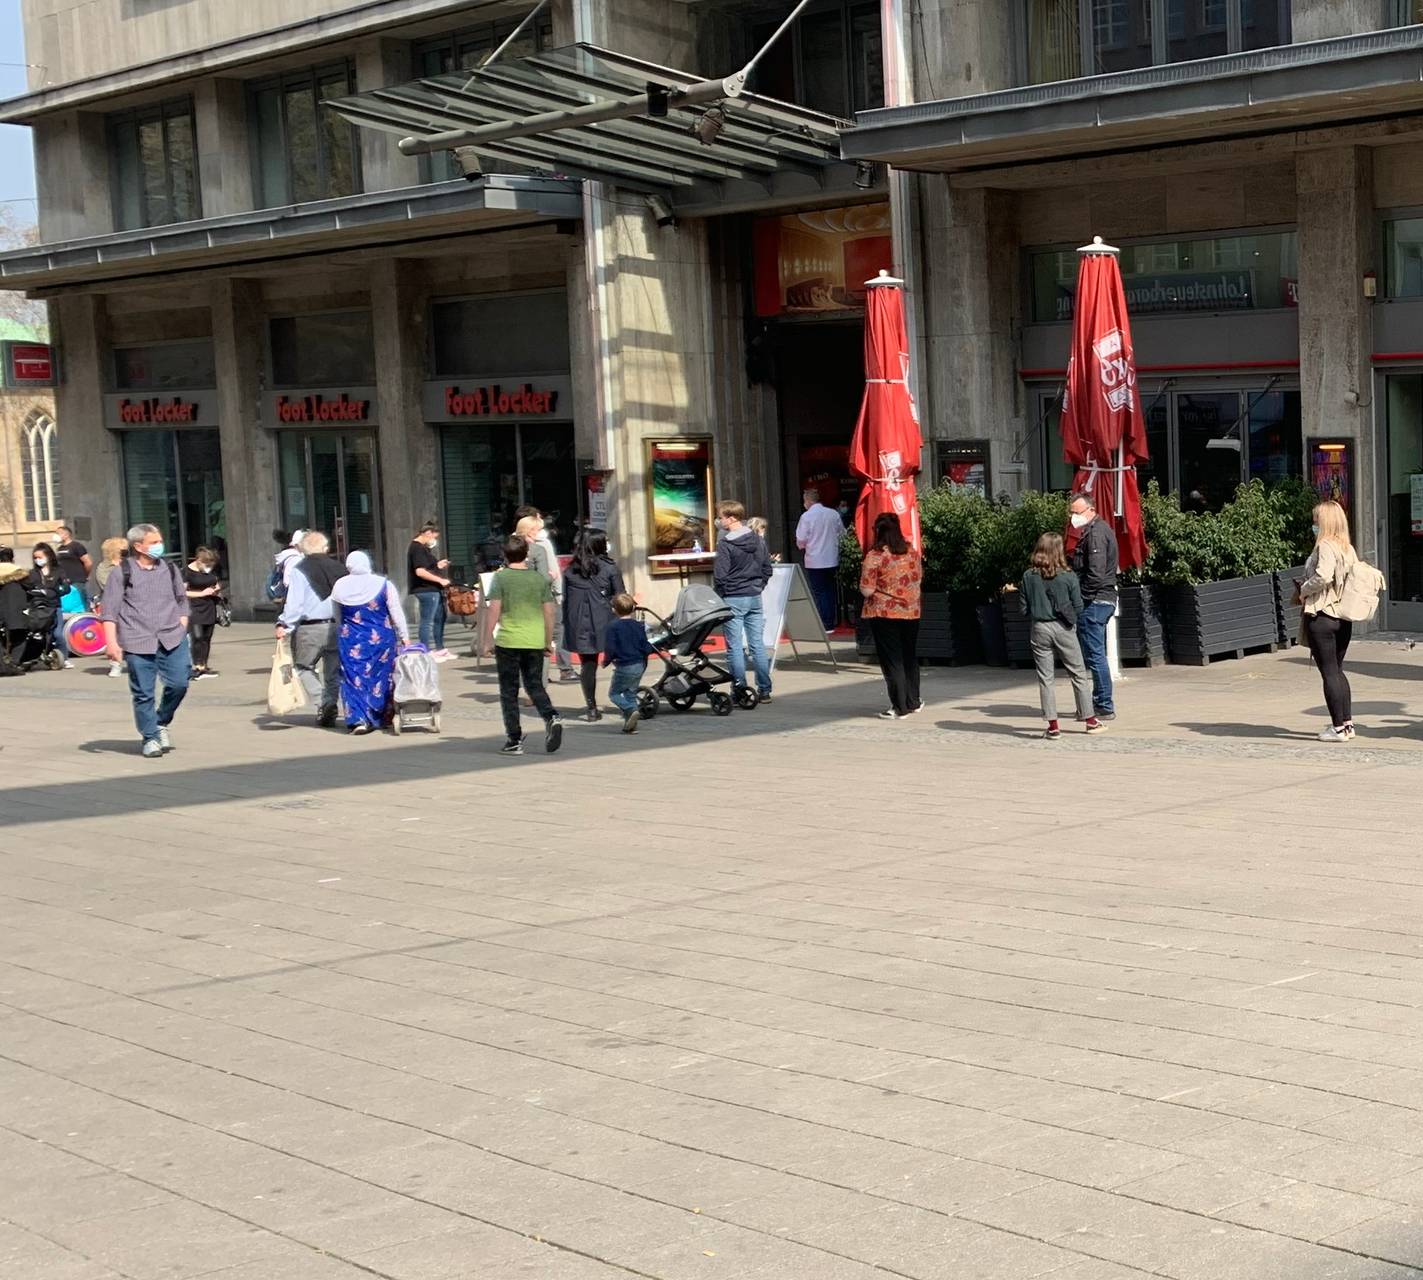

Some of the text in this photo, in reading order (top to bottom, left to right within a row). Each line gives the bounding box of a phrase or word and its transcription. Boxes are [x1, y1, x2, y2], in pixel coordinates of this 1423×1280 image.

[117, 398, 195, 422] Foot Locker
[275, 394, 365, 422] Foot Locker
[444, 384, 553, 416] Foot Locker
